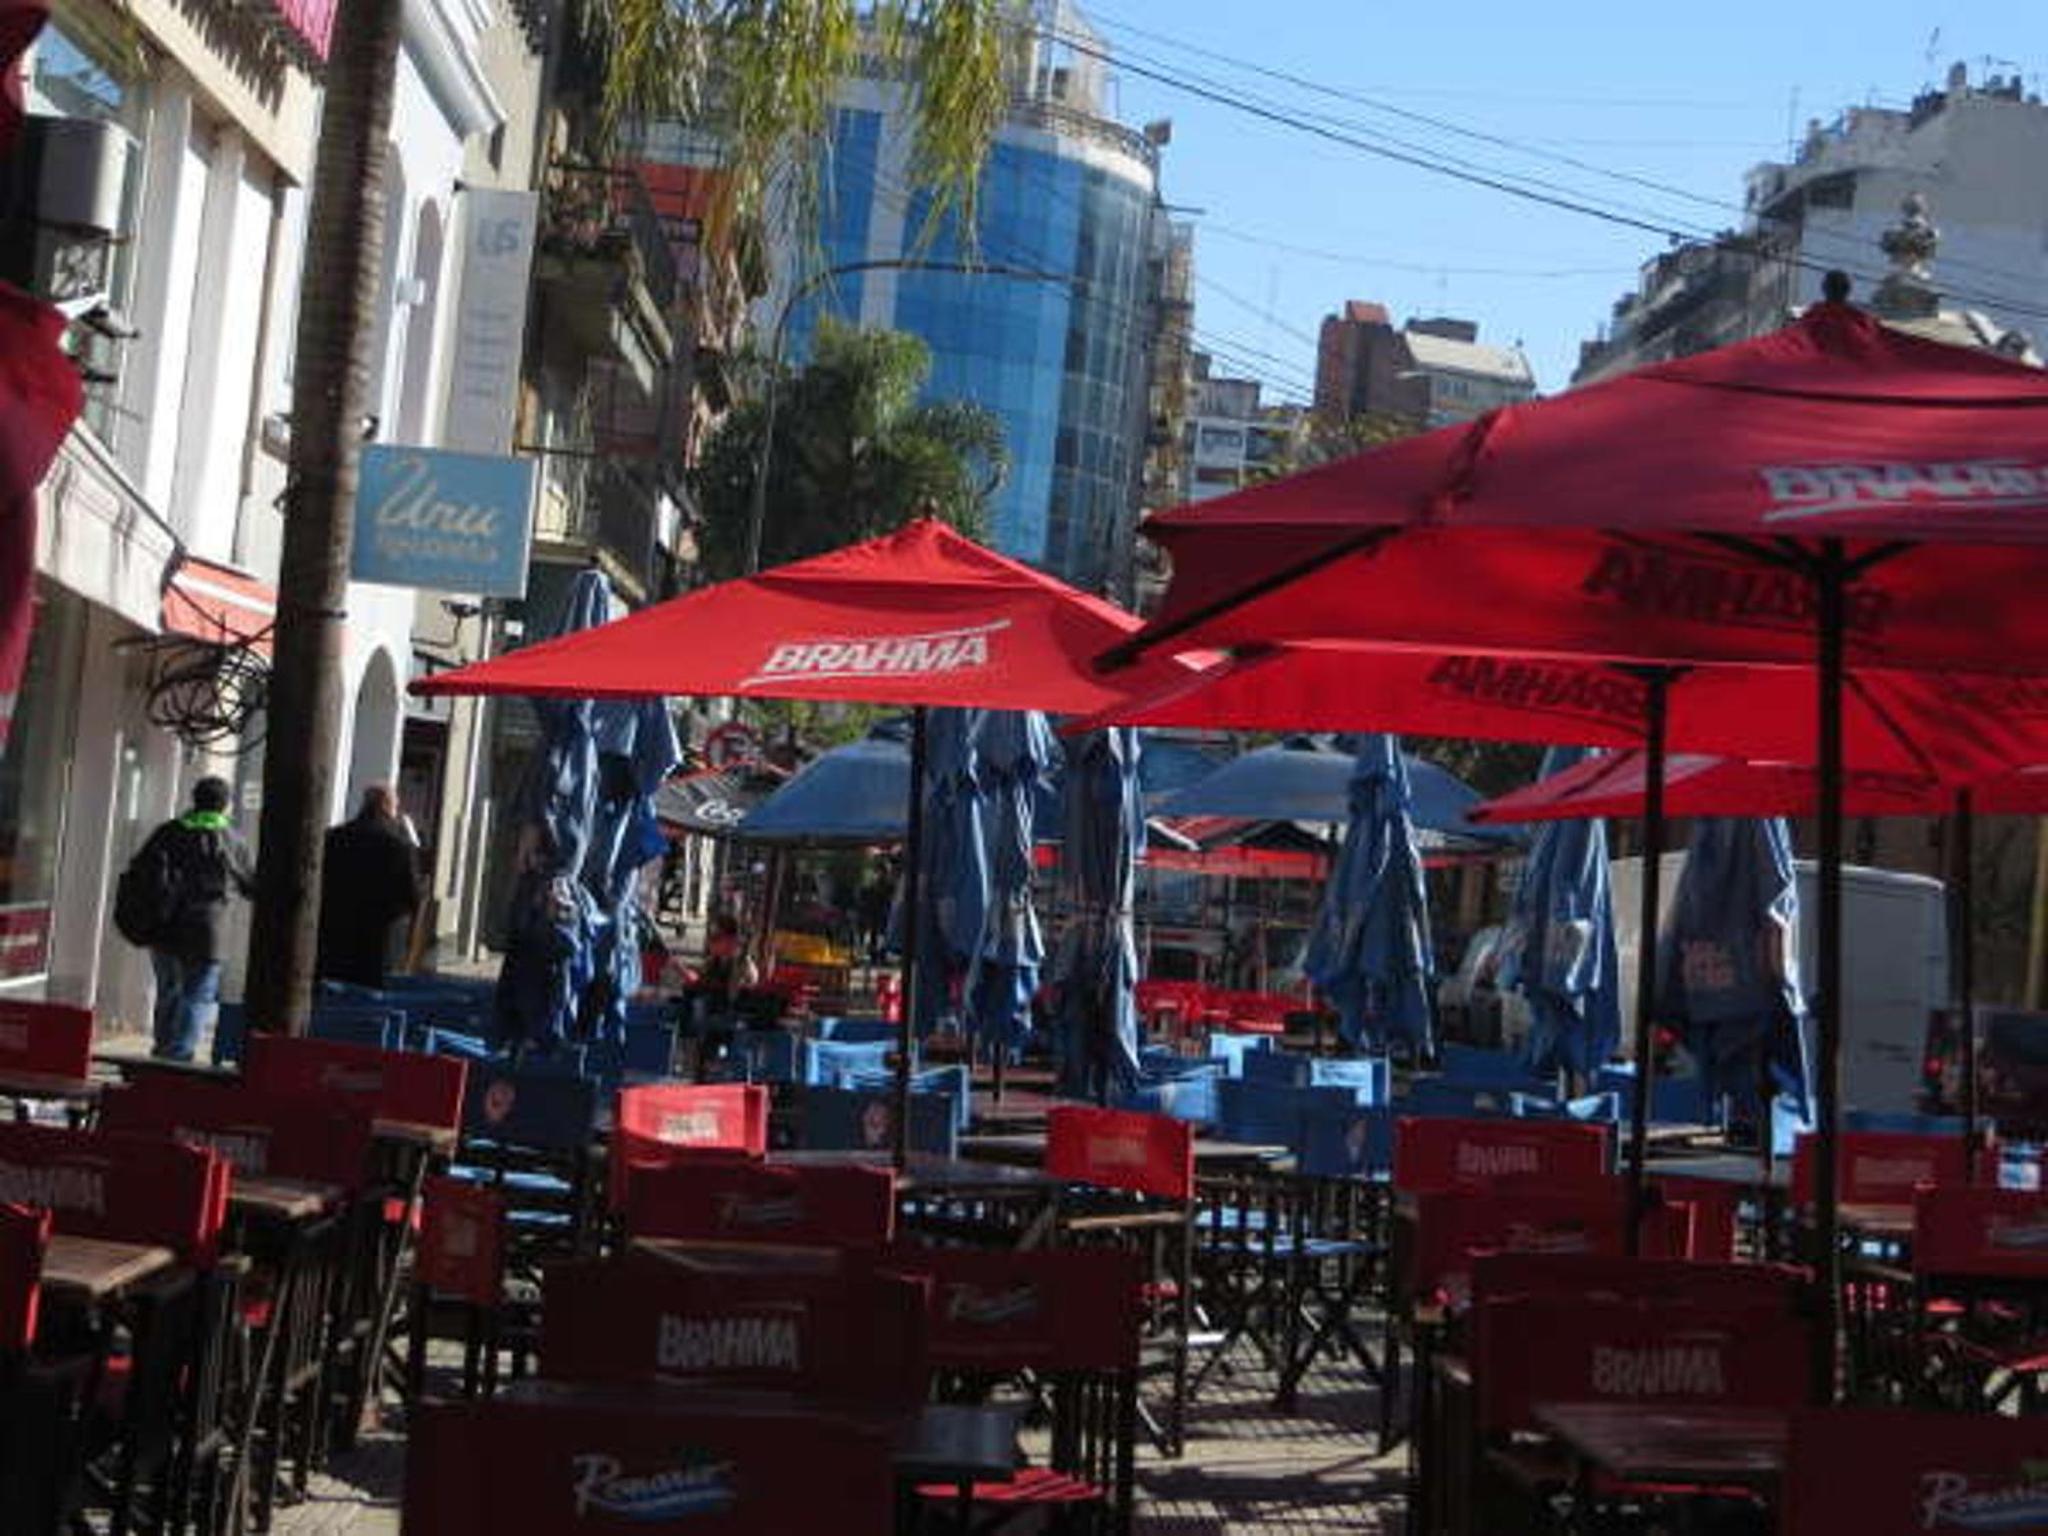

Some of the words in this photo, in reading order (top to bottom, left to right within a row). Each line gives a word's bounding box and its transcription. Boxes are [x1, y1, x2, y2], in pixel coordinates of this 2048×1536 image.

[762, 633, 989, 673] BRAHMA
[657, 1312, 800, 1372] BRAHMA
[1591, 1346, 1725, 1395] BRAHMA
